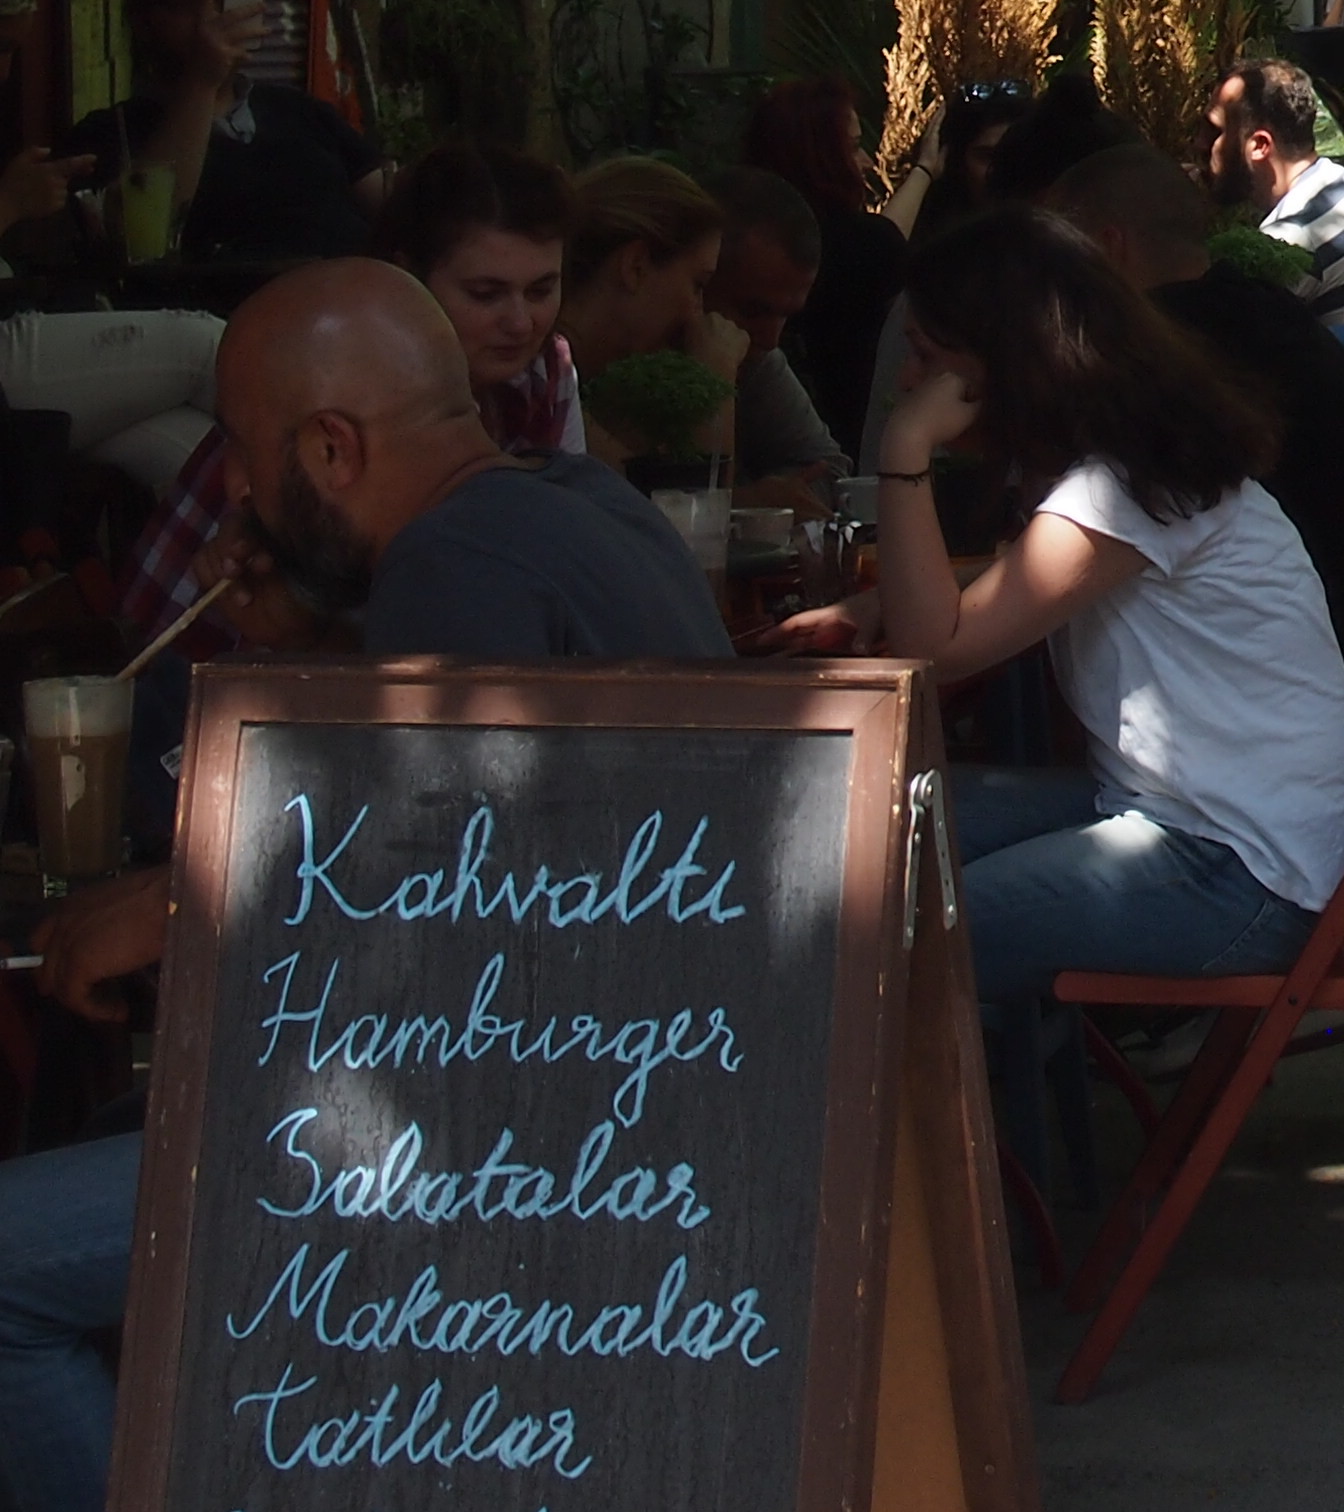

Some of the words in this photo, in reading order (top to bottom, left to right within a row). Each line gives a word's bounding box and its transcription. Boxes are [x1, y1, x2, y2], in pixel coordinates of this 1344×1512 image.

[283, 791, 747, 929] Kahvaltı
[257, 951, 745, 1129] Hamburger
[257, 1105, 711, 1230] Salatalar
[226, 1242, 780, 1368] Makarnalar
